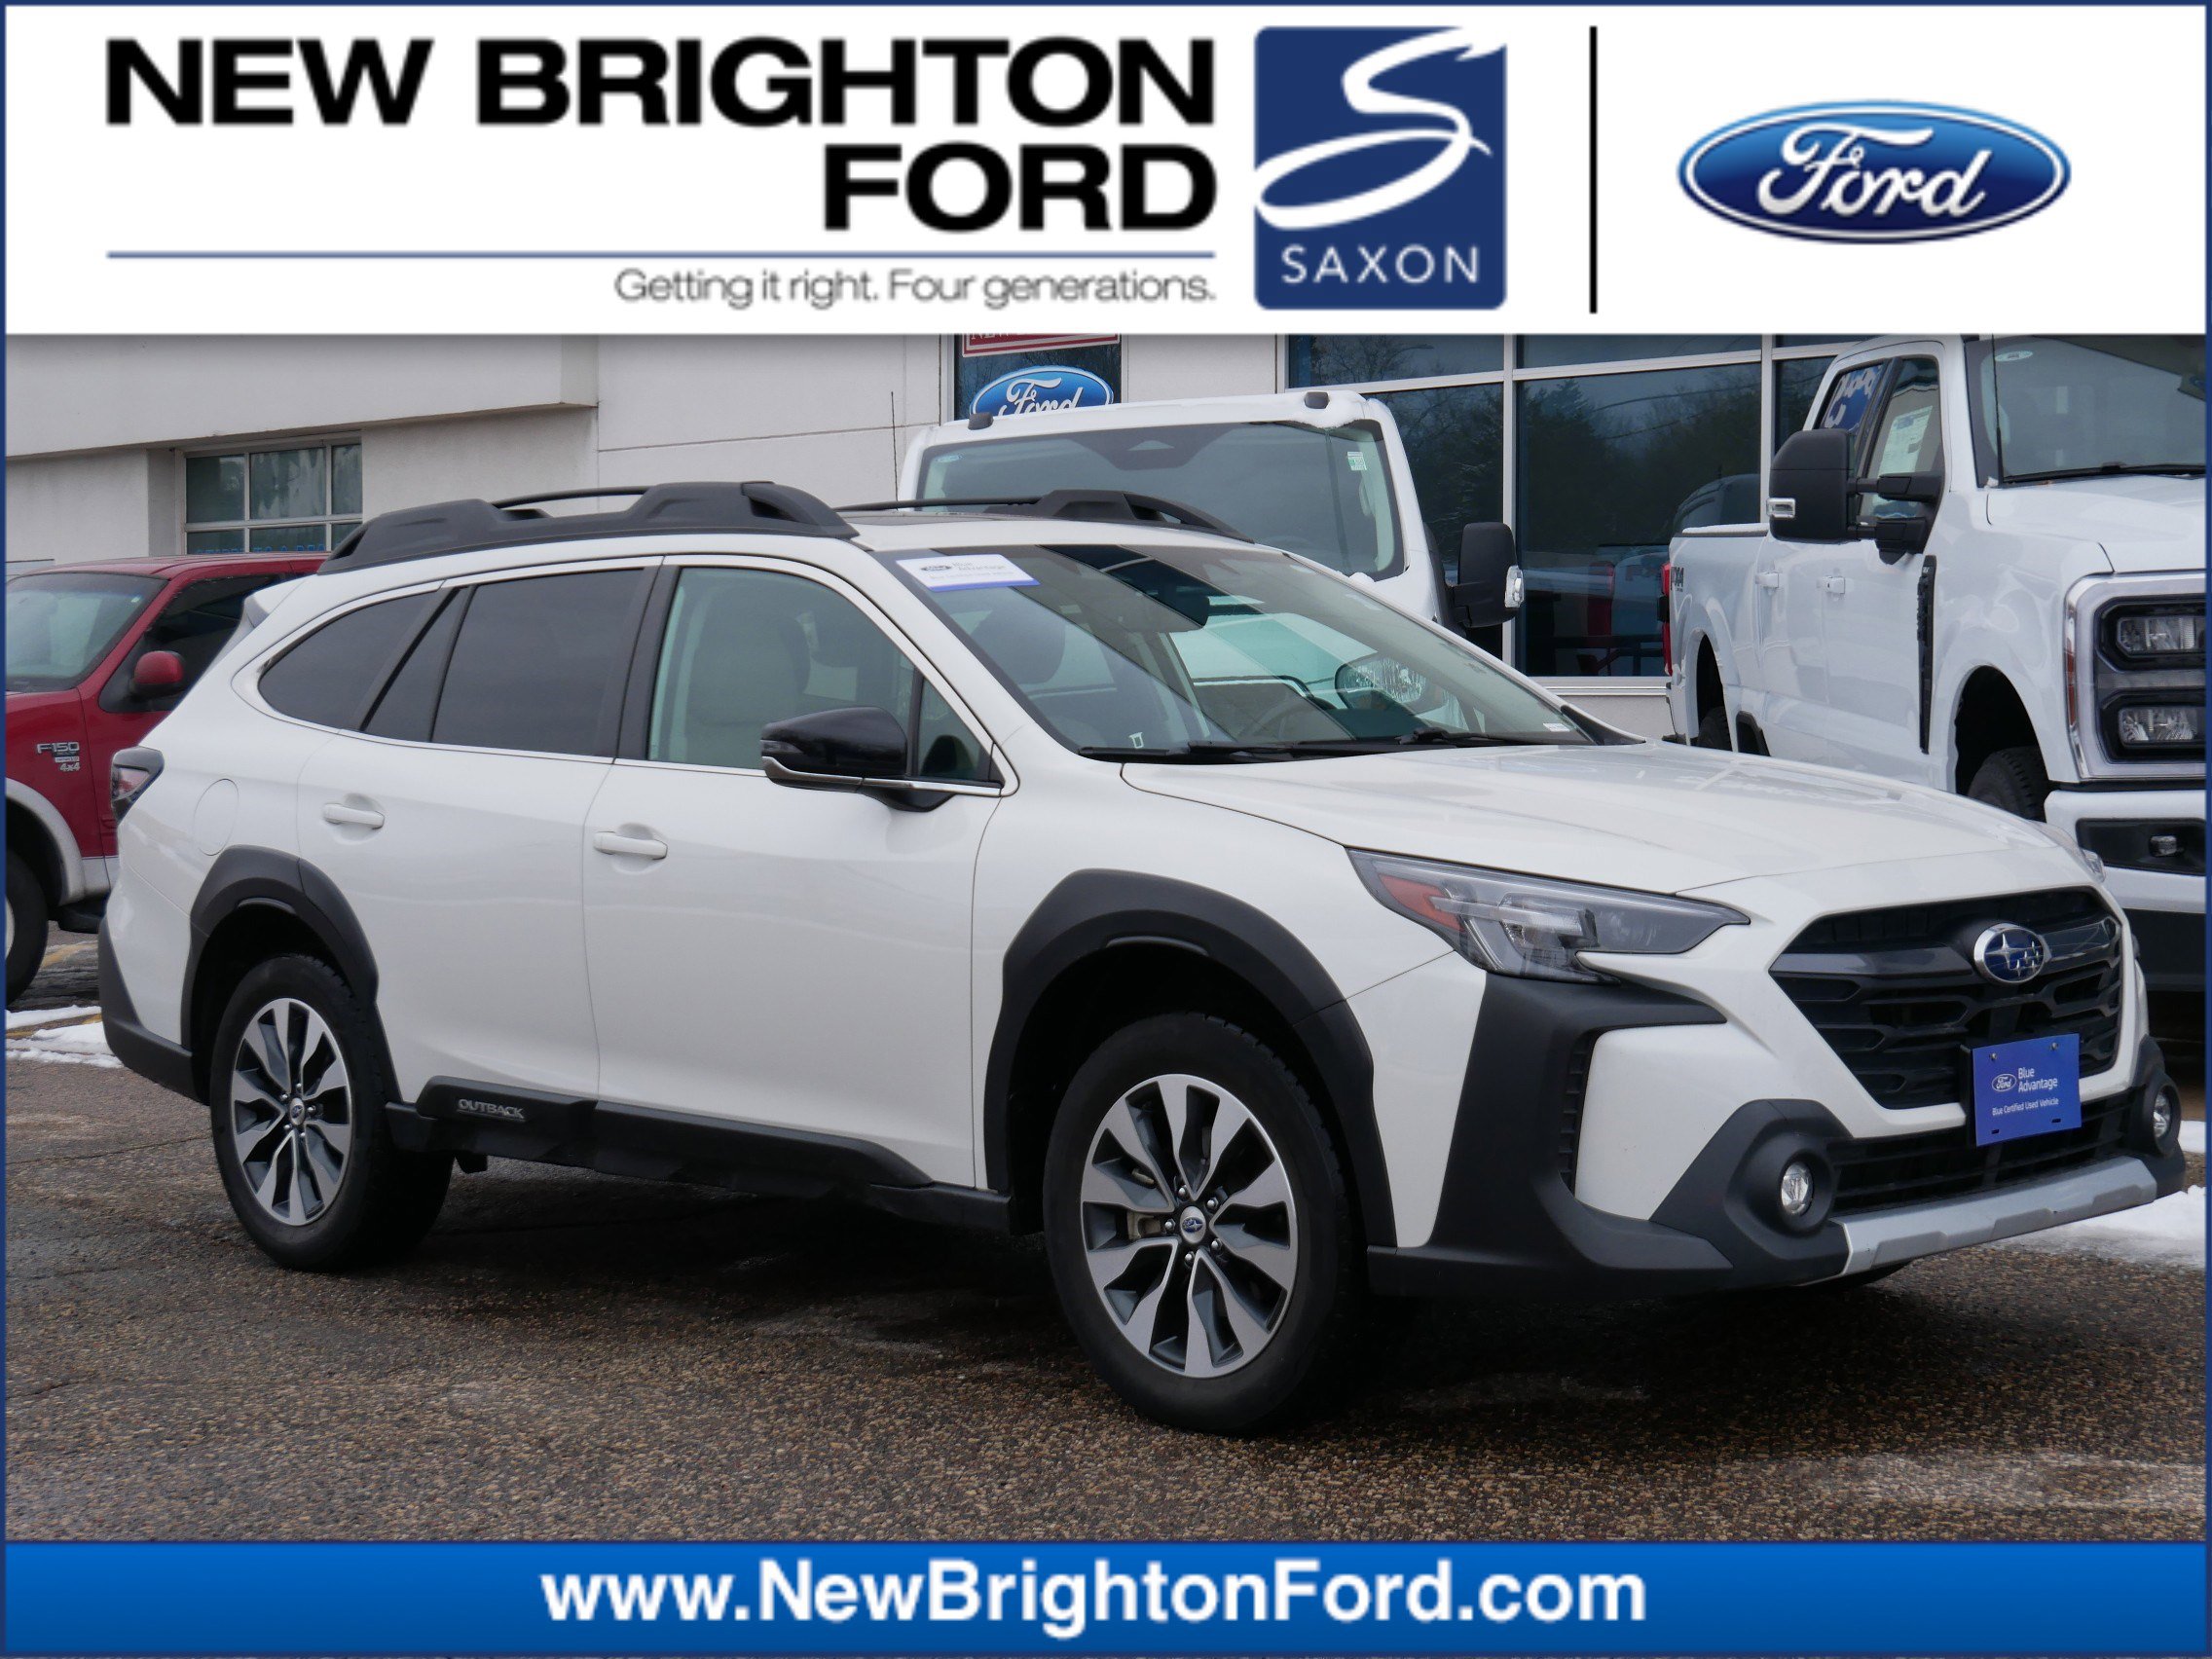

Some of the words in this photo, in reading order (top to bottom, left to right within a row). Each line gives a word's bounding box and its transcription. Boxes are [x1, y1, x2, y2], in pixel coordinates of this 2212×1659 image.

[2018, 1067, 2035, 1079] Blue
[2017, 1078, 2058, 1092] Advantage
[458, 1098, 525, 1120] OUTBACK
